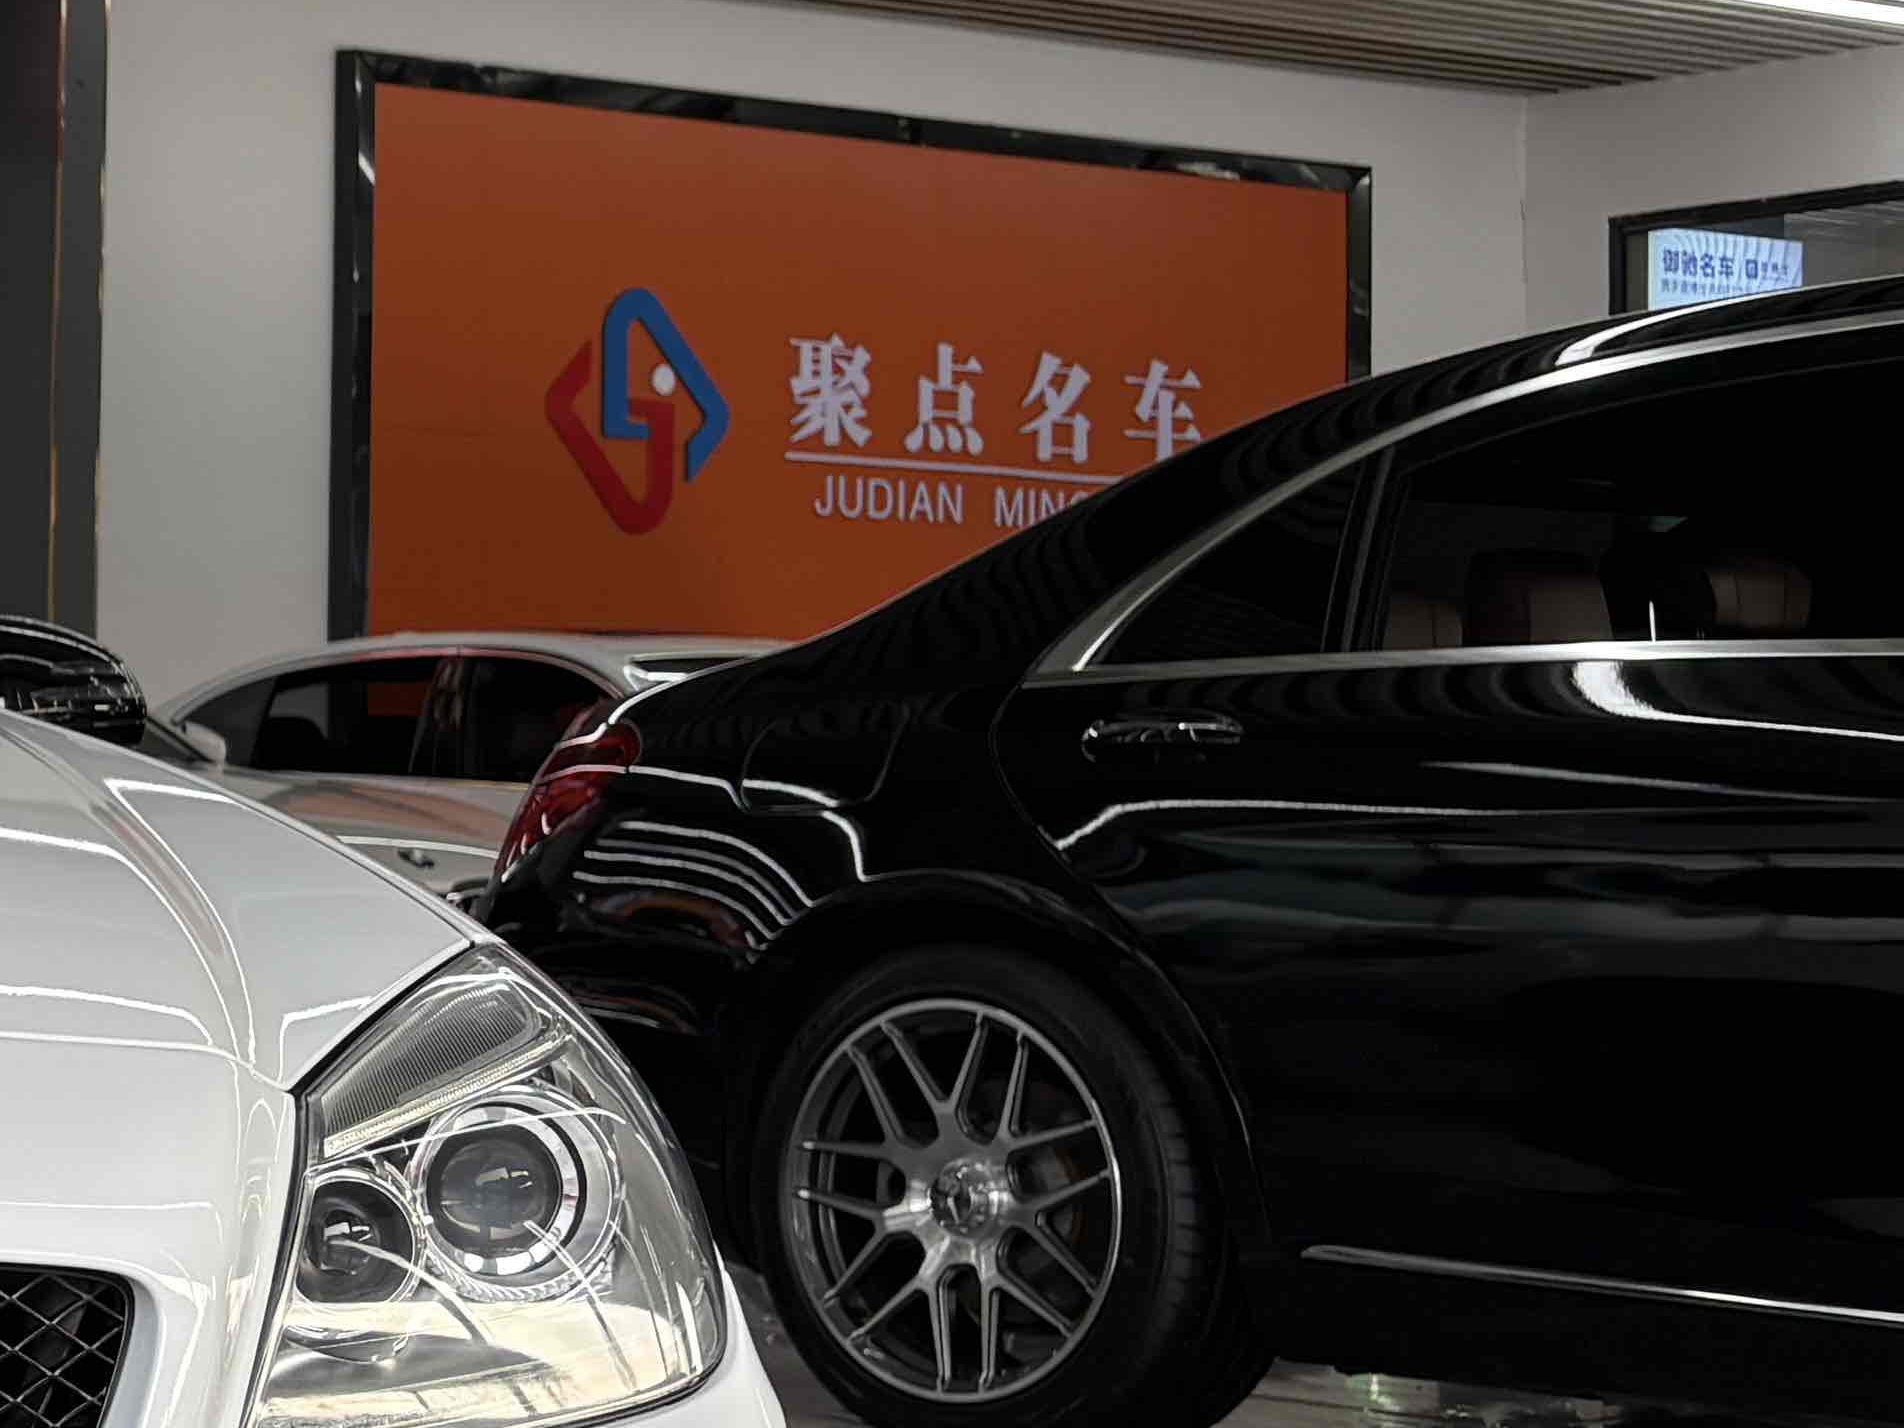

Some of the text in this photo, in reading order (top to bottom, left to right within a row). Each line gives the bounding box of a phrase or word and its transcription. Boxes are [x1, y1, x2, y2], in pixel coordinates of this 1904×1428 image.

[789, 332, 1201, 463] 聚点名车
[814, 475, 965, 525] JUDIAN
